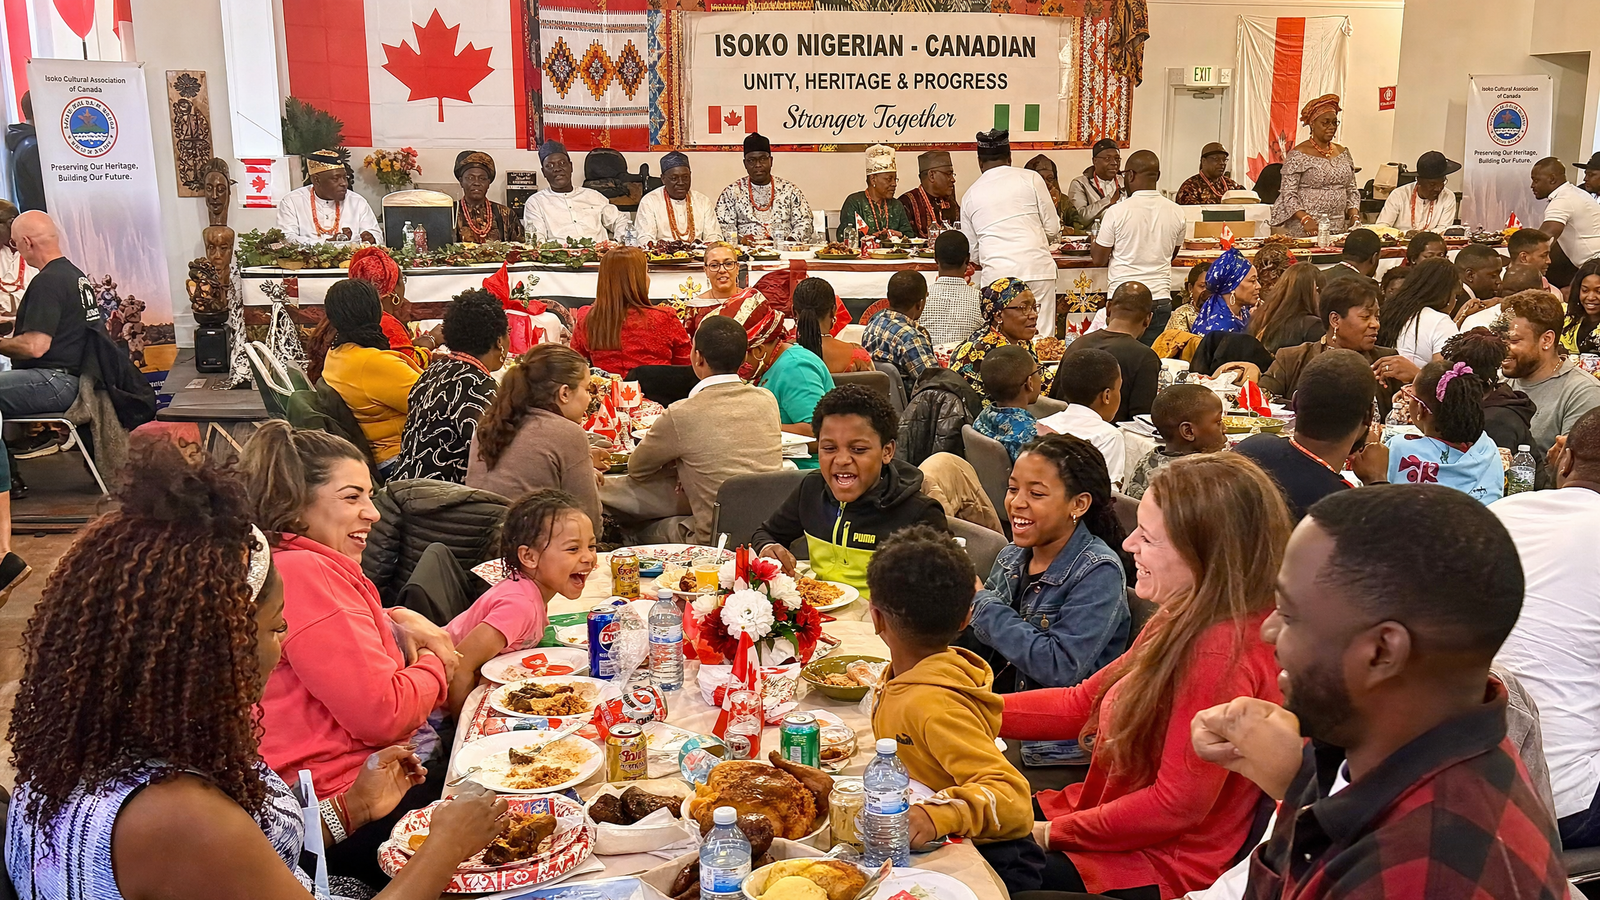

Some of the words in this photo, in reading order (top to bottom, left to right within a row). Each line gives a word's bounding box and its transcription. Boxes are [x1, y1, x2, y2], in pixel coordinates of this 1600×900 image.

[715, 33, 789, 57] ISOKO
[797, 33, 904, 57] NIGERIAN
[925, 34, 1036, 58] CANADIAN
[45, 75, 62, 83] Isoko
[1194, 66, 1212, 82] EXIT
[743, 72, 800, 92] UNITY,
[805, 72, 892, 90] HERITAGE
[897, 72, 909, 90] &
[914, 72, 1008, 90] PROGRESS
[783, 104, 867, 136] Stronger
[873, 102, 956, 136] Together
[50, 163, 89, 172] Preserving
[58, 174, 88, 182] Building
[89, 173, 103, 181] Our
[105, 173, 132, 181] Future.
[852, 532, 876, 544] PUMA
